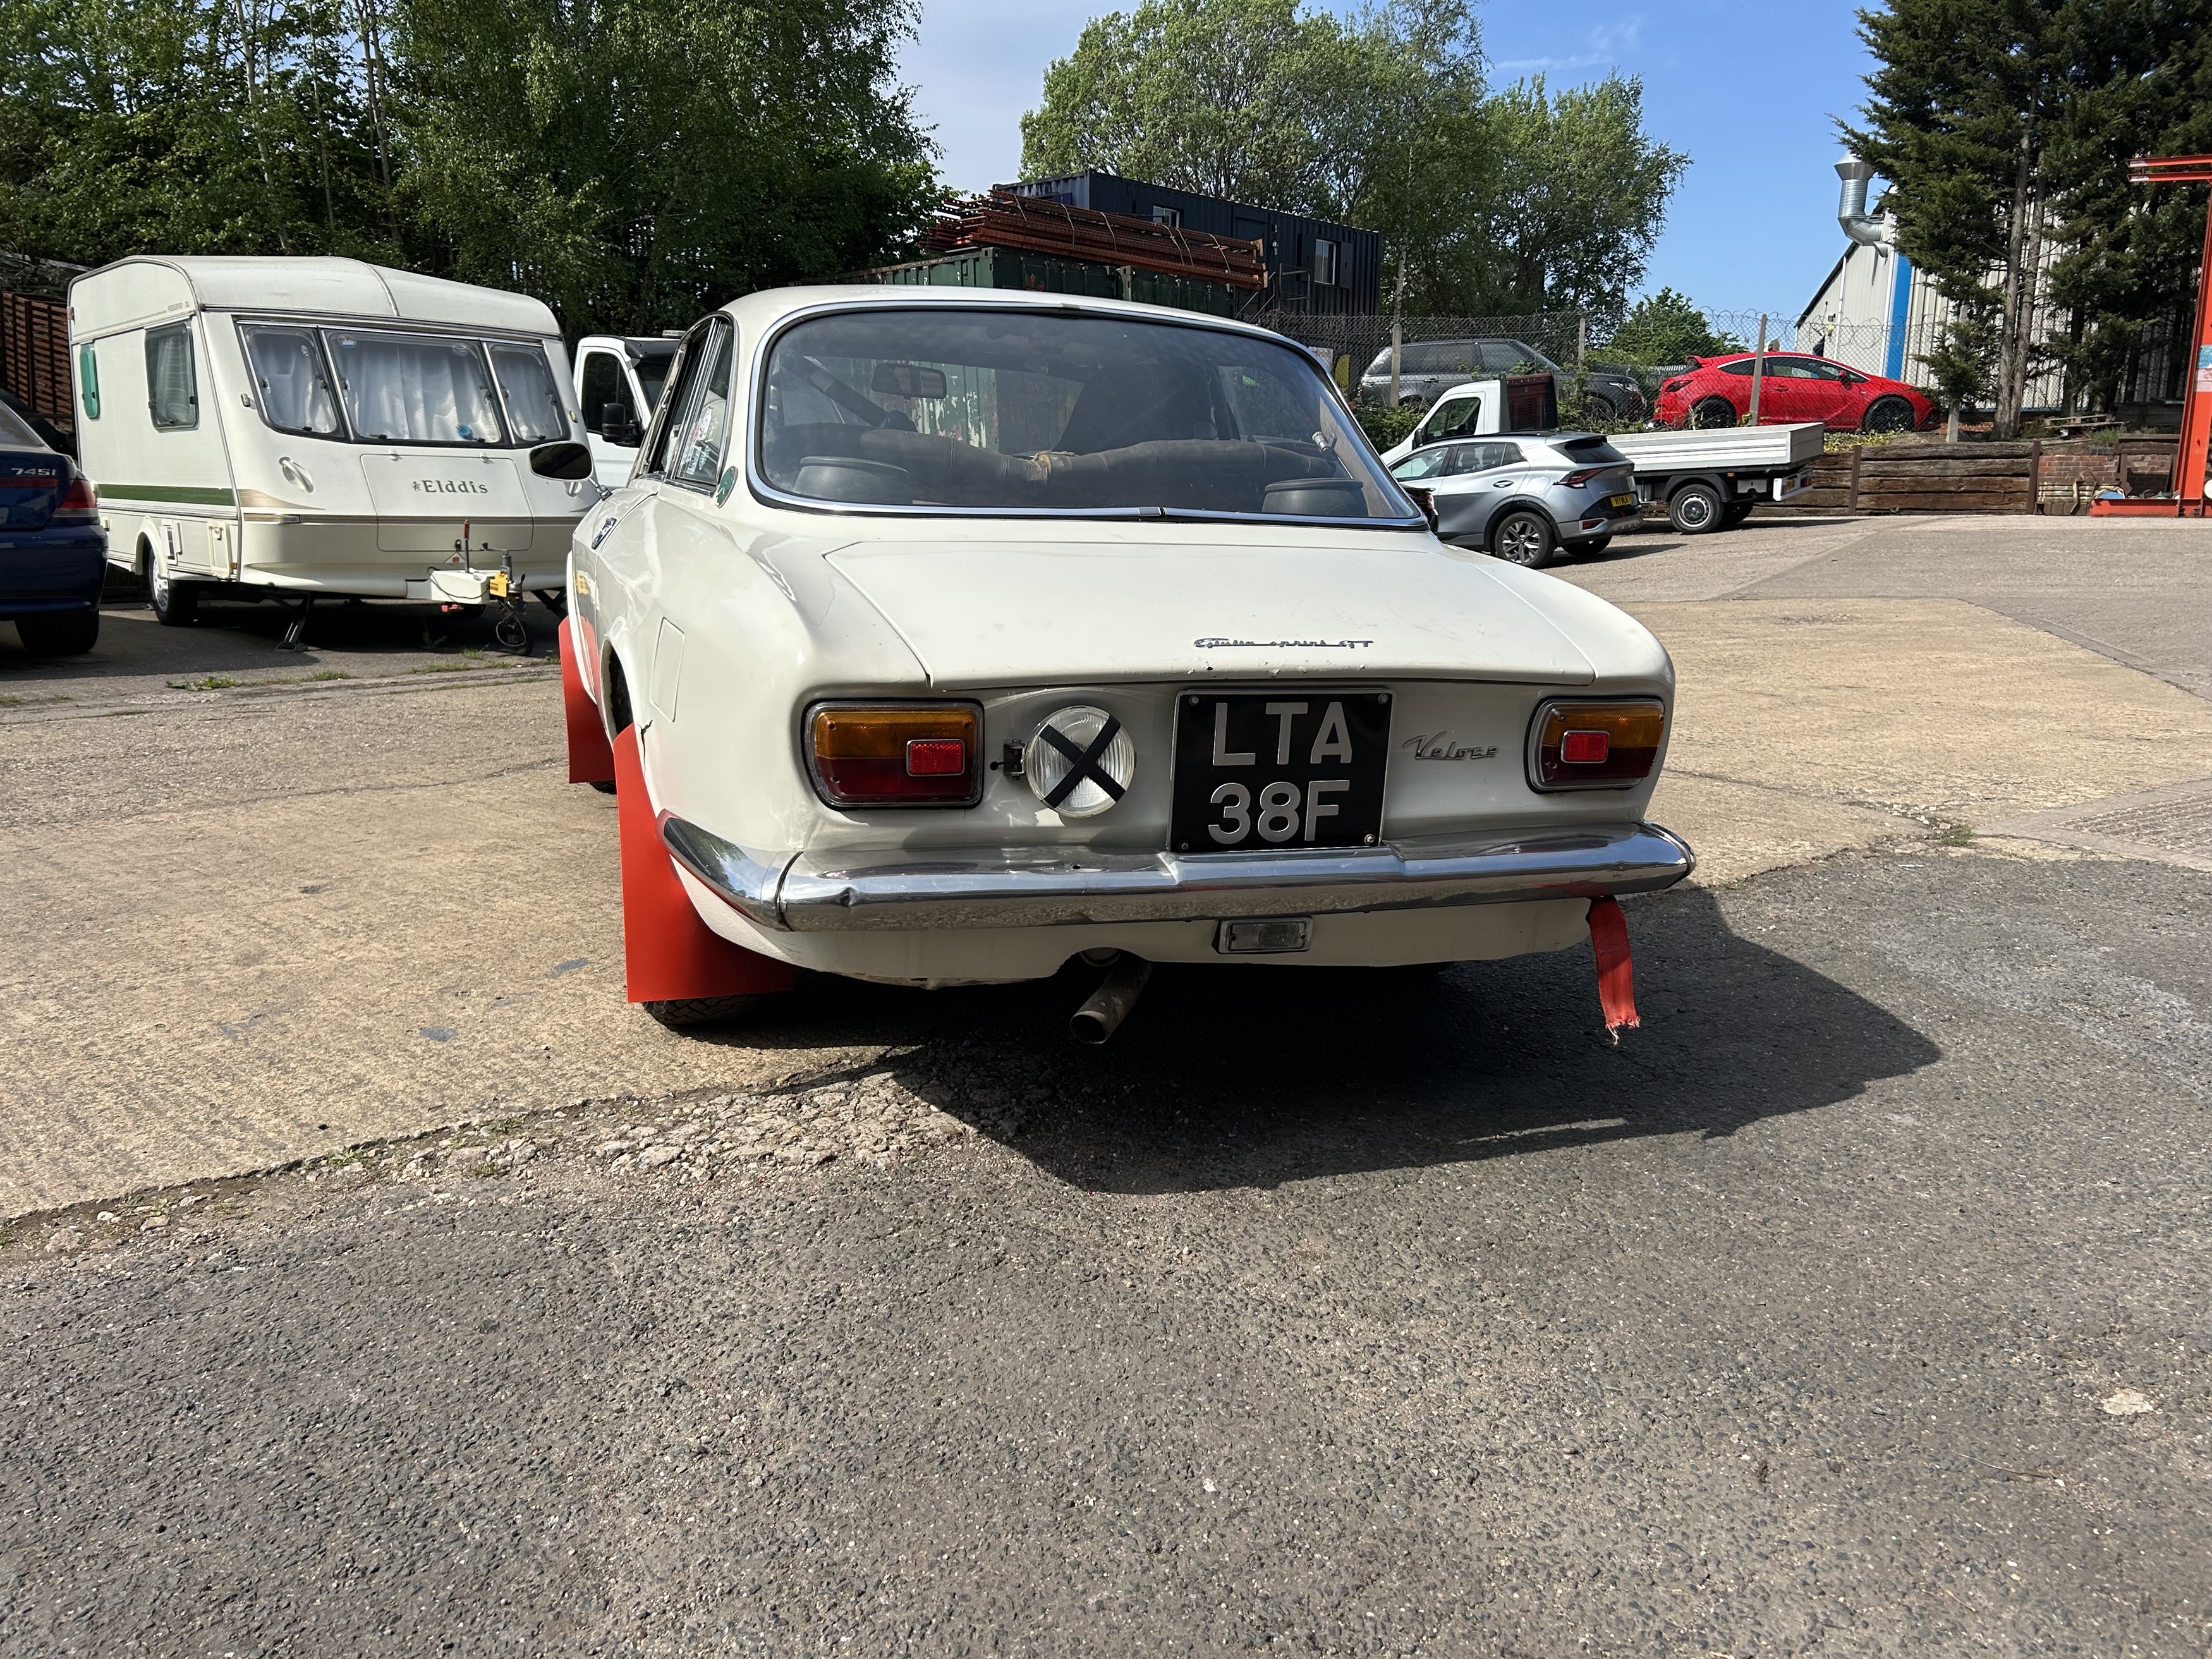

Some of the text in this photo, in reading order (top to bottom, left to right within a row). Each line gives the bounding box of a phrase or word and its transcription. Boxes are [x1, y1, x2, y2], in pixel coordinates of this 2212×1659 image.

[421, 480, 488, 494] Elddis
[1339, 640, 1374, 649] GT
[1212, 702, 1352, 766] LTA
[1402, 730, 1498, 760] Veloce
[1208, 780, 1350, 844] 38F
